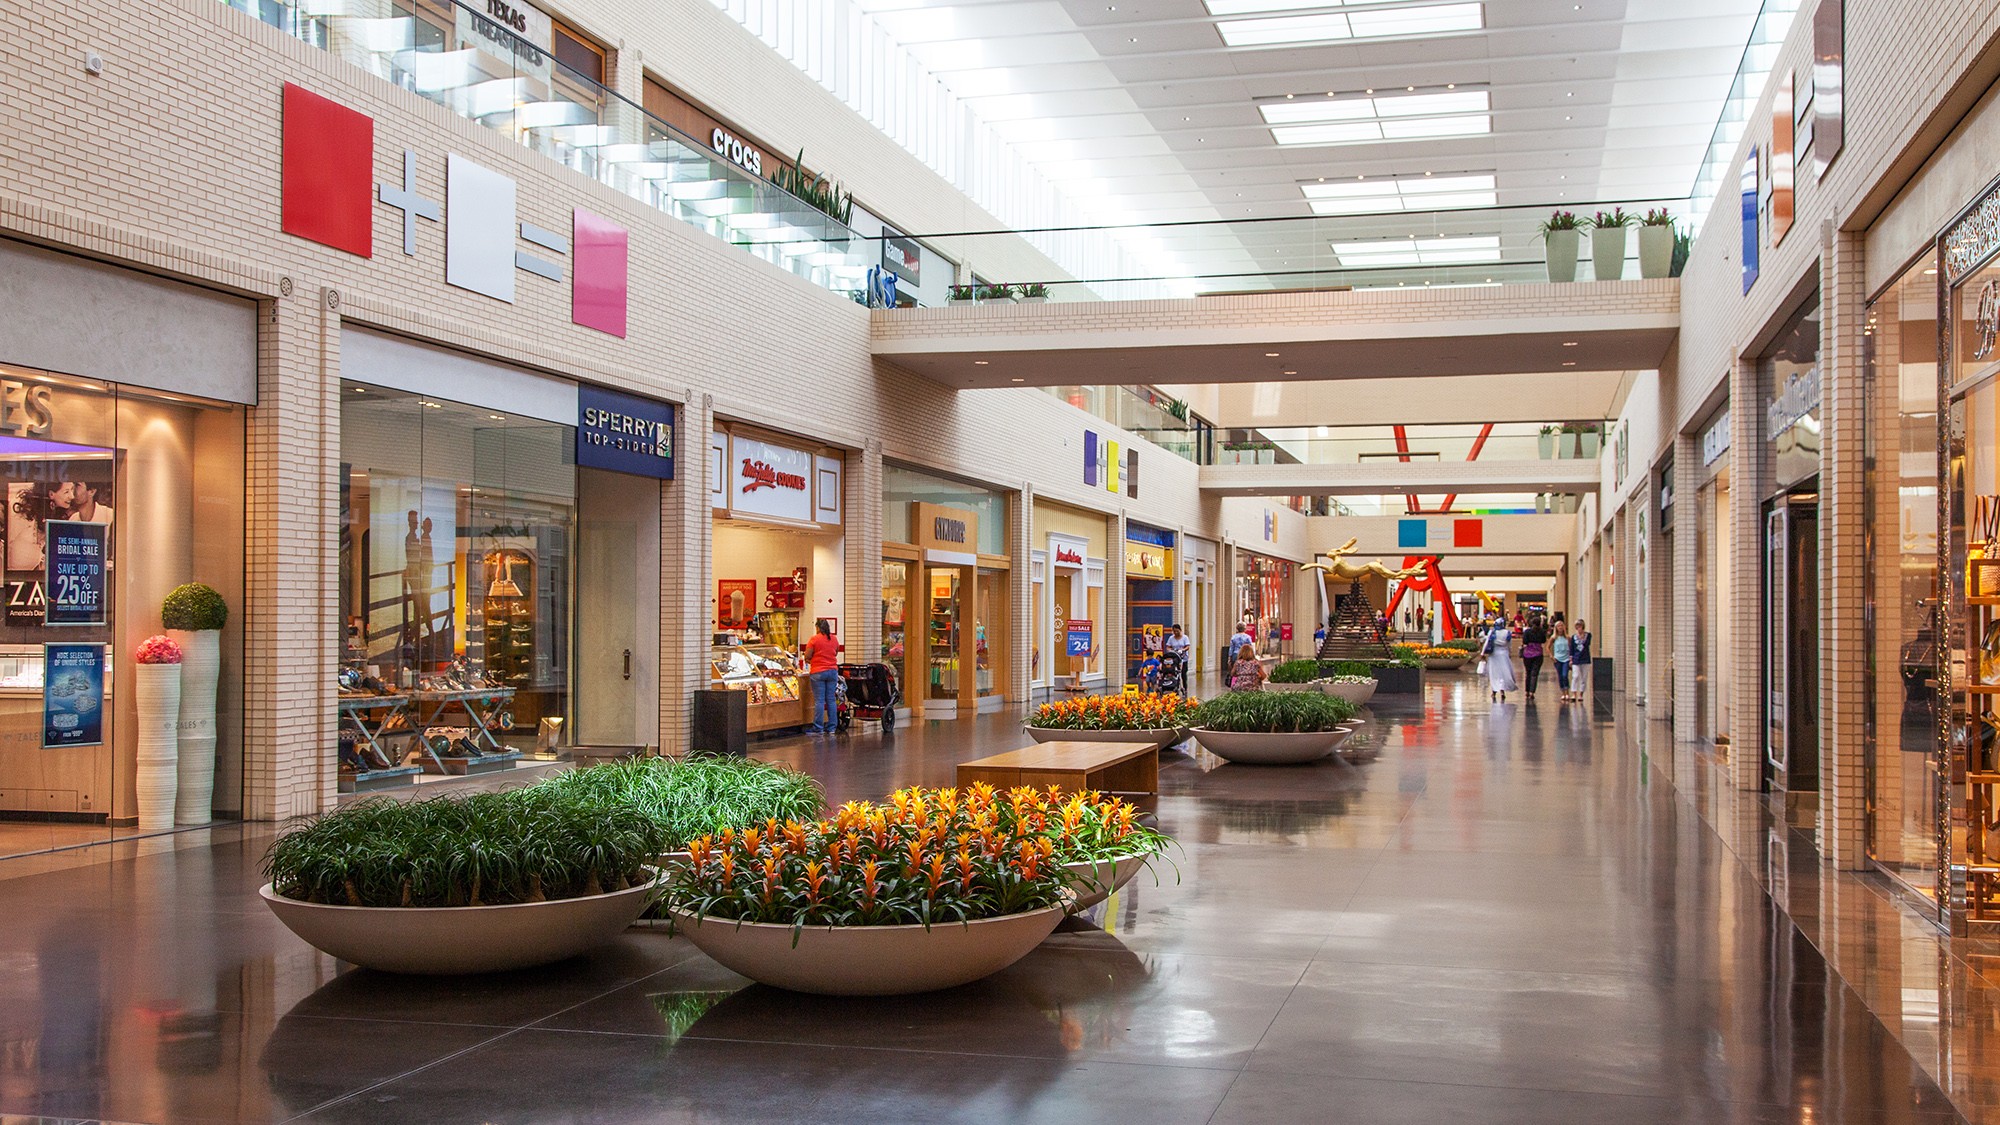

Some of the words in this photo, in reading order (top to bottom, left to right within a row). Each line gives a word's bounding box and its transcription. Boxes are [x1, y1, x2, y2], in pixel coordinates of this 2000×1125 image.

[487, 0, 526, 32] TEXAS
[713, 127, 761, 176] crocs
[585, 407, 655, 438] SPERRY
[586, 431, 654, 455] TOP-SIDER
[777, 471, 806, 491] COOKIES
[58, 545, 81, 555] BRIDAL
[83, 546, 98, 556] SALE
[58, 563, 76, 574] SAVE
[78, 564, 88, 574] UP
[89, 564, 98, 575] TO
[80, 591, 98, 604] OFF
[175, 721, 196, 729] ZALES
